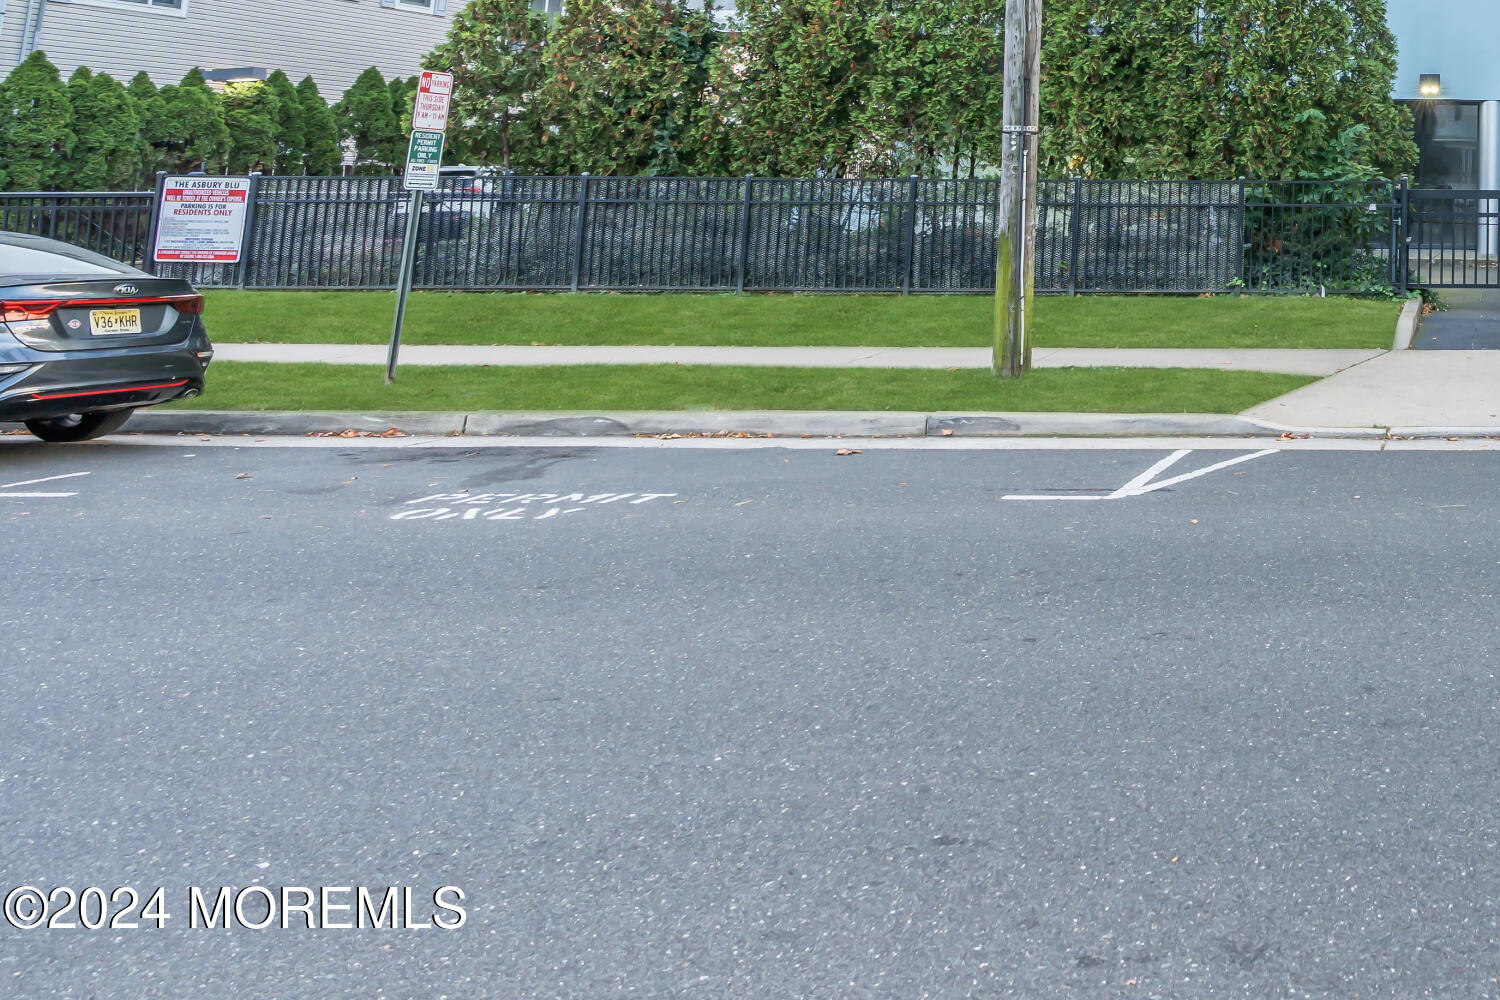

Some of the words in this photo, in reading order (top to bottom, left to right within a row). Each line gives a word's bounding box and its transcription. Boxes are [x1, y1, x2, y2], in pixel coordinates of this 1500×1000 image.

[422, 76, 430, 88] NO
[432, 80, 449, 88] PARKING
[420, 103, 444, 112] THURSDAY
[192, 181, 222, 189] ASBURY
[120, 286, 136, 294] KIA
[403, 493, 678, 504] PERMIT
[390, 508, 586, 520] ONLY
